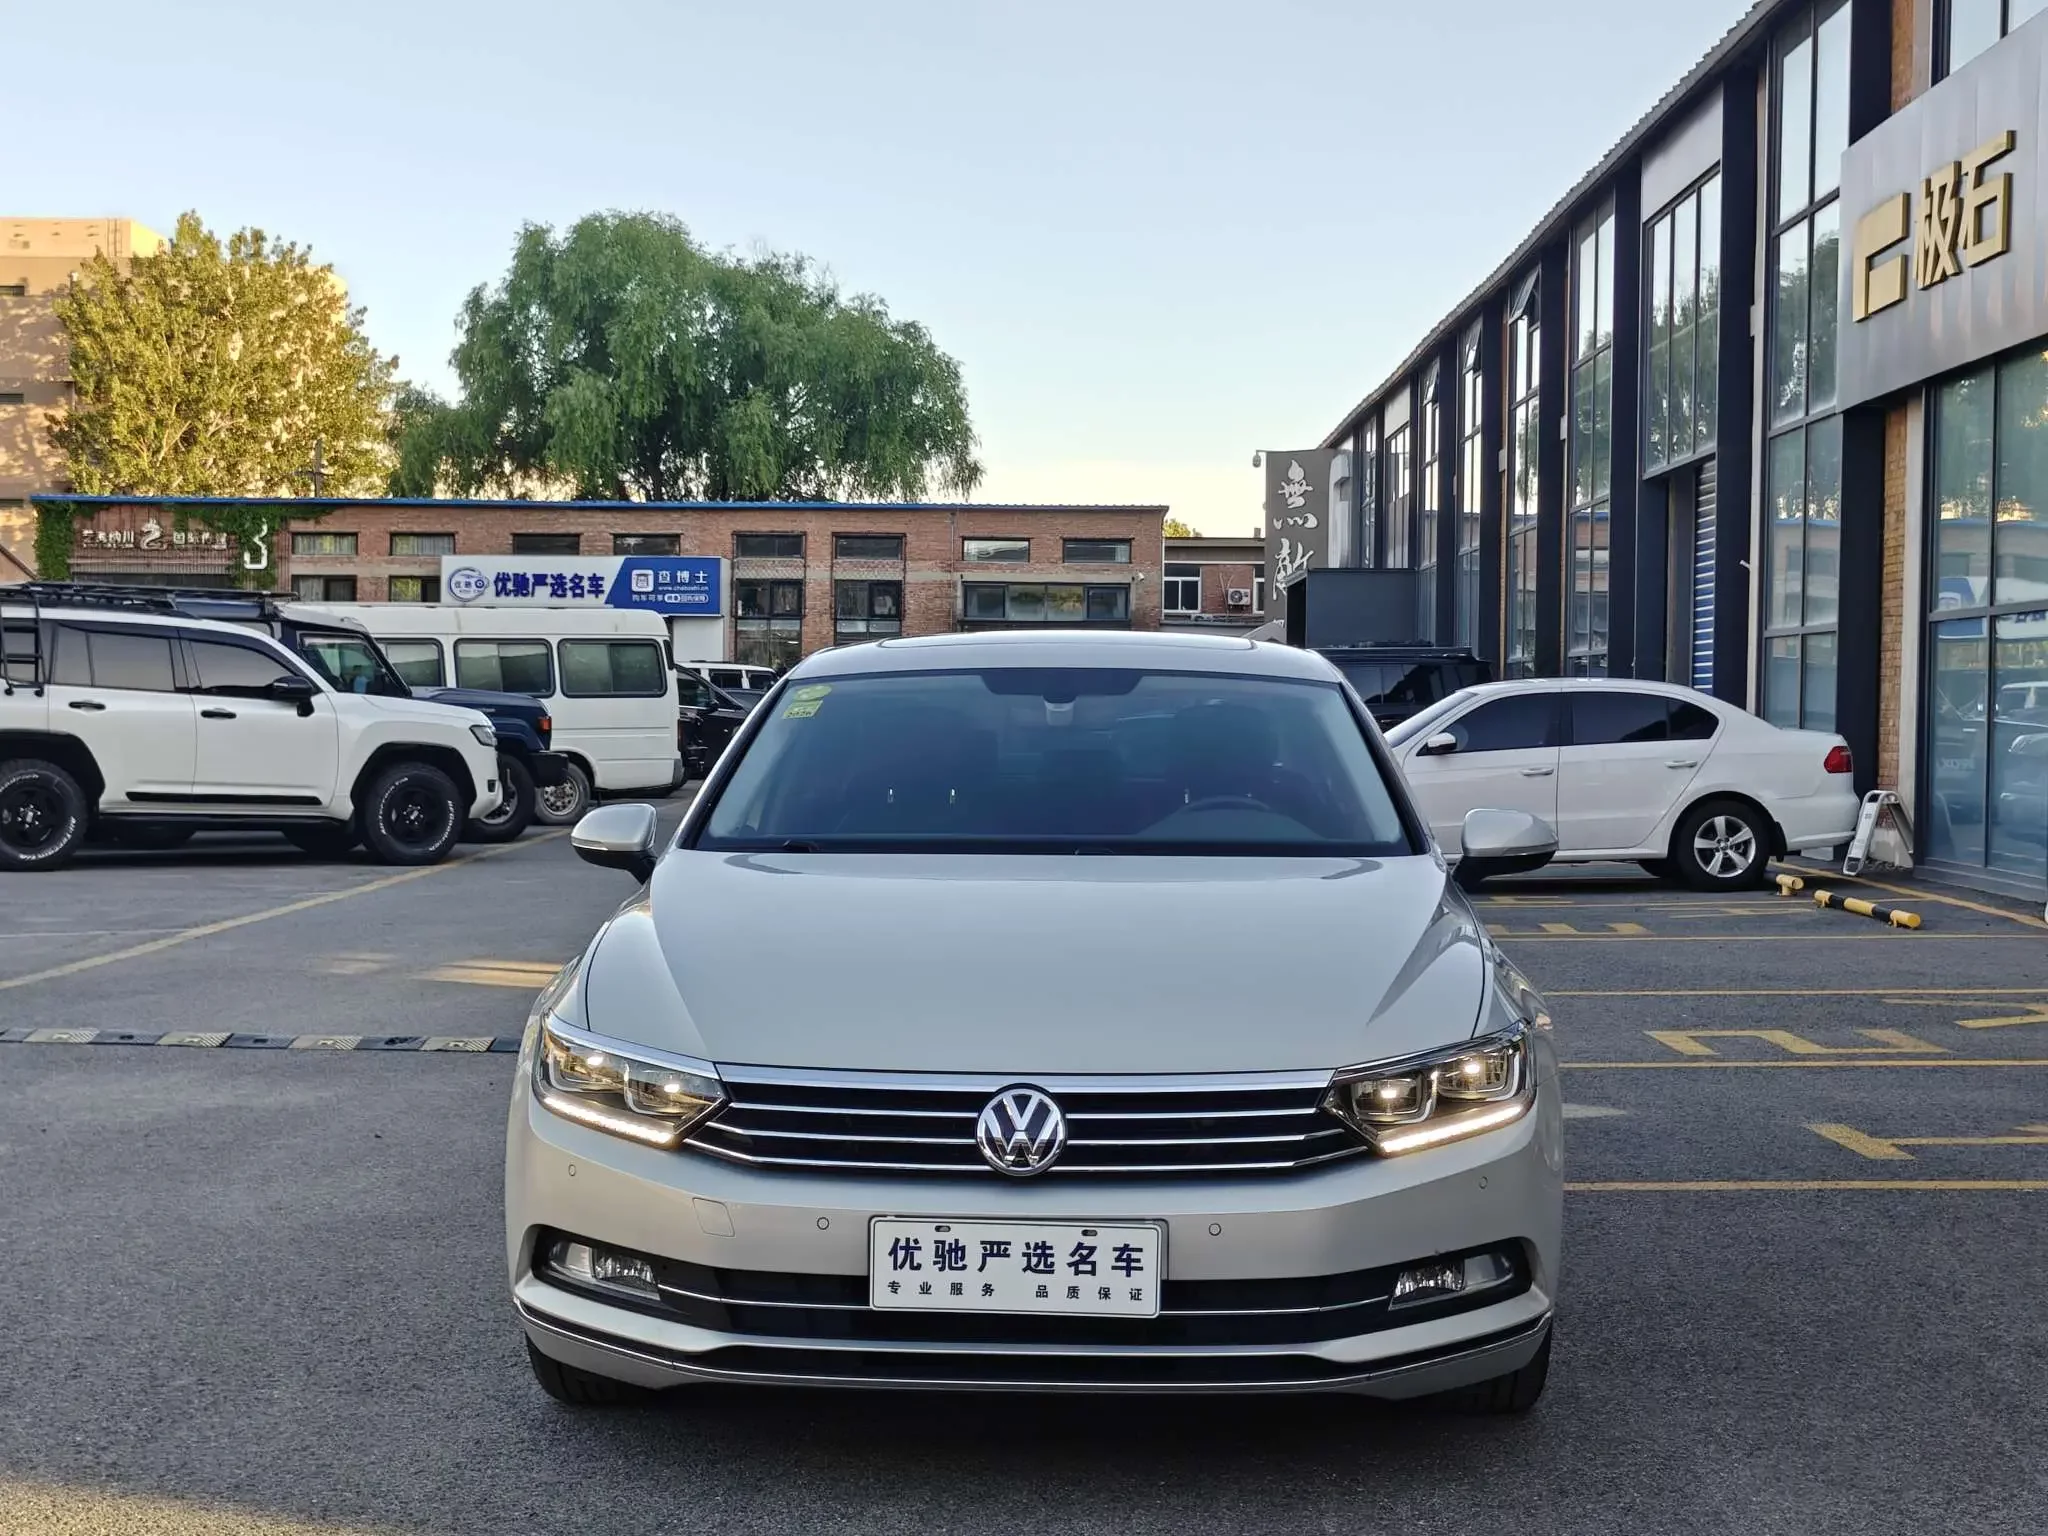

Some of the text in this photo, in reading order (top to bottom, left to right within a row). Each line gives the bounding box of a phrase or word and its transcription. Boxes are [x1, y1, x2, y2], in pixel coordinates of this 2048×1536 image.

[1913, 130, 2016, 290] 极石
[493, 572, 605, 598] 优驰严选名车
[658, 570, 708, 584] 查博士
[888, 1236, 1144, 1278] 优驰严选名车
[887, 1280, 1143, 1302] 专业服务 品质保证
